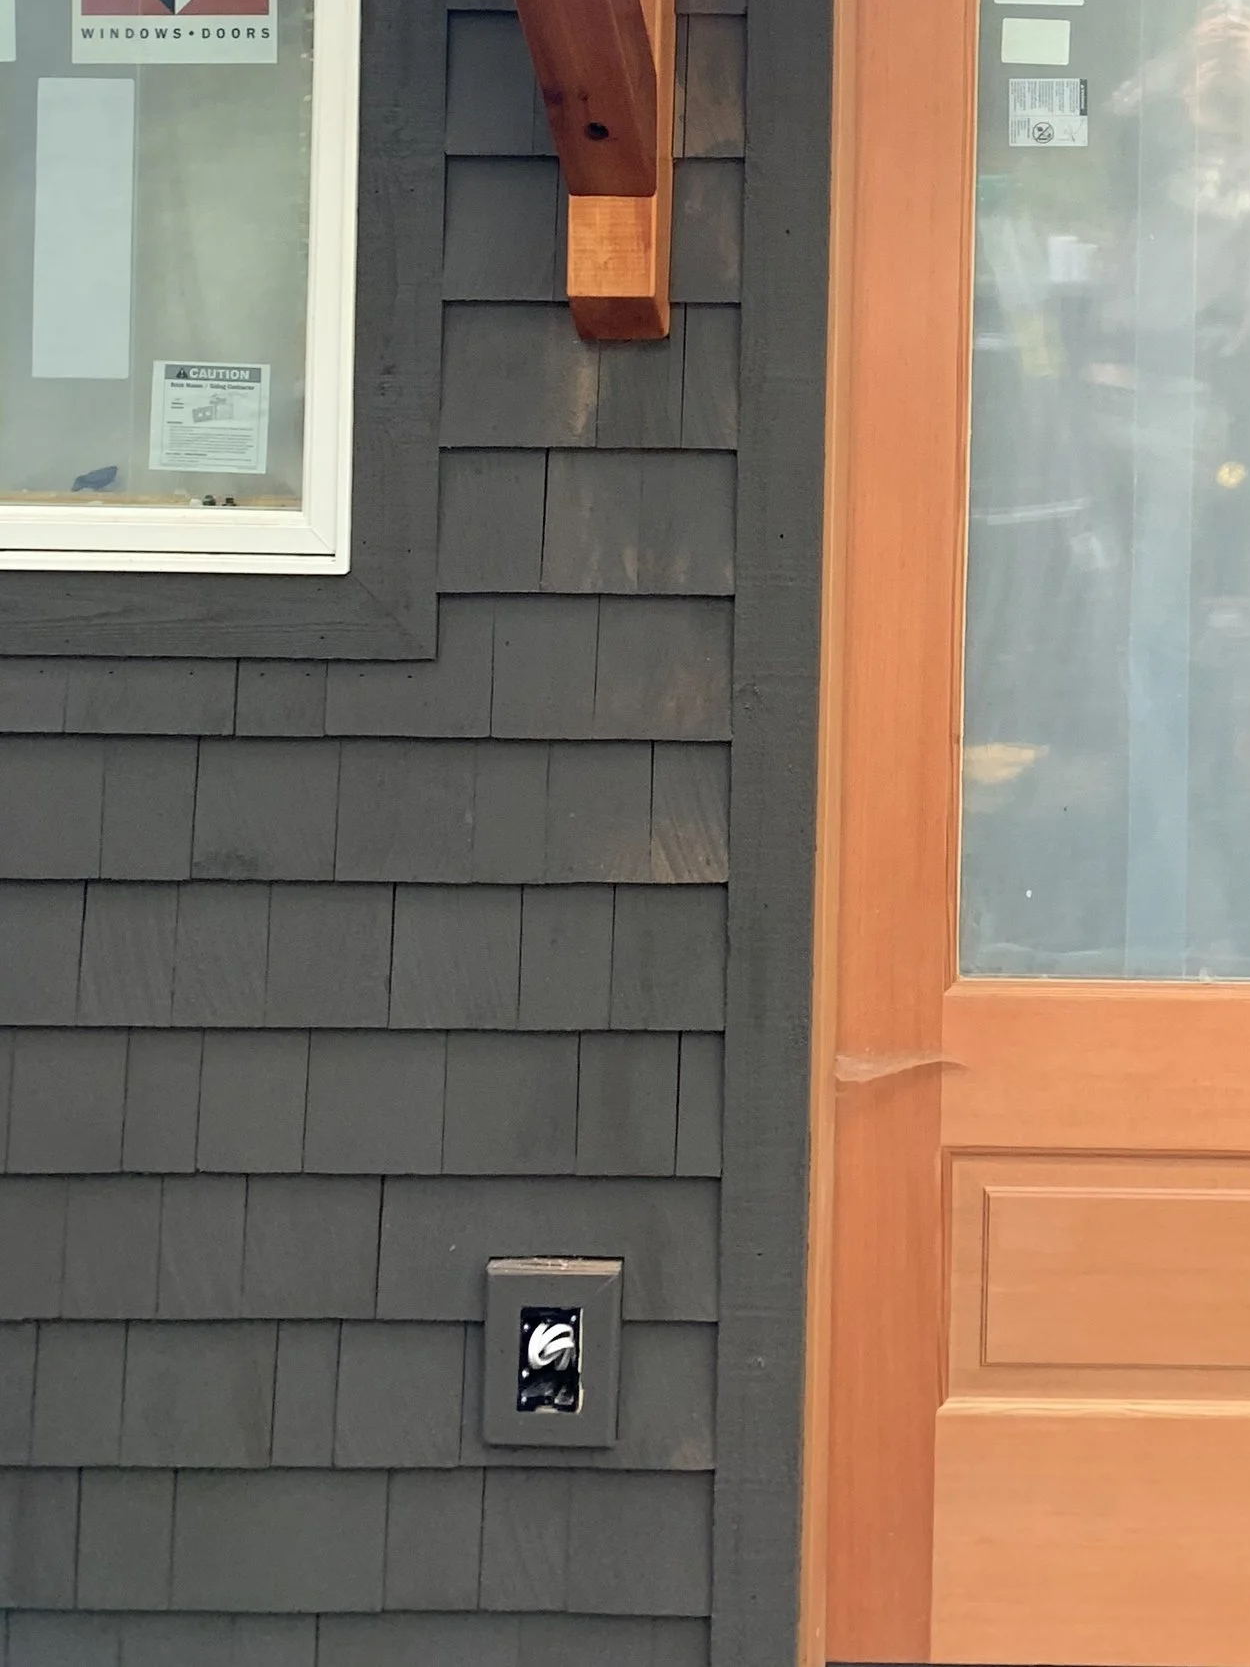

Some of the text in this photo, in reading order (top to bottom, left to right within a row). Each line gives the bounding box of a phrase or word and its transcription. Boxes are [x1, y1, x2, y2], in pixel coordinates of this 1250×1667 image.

[81, 27, 270, 40] WINDOWS DOORS
[189, 368, 250, 380] CAUTION
